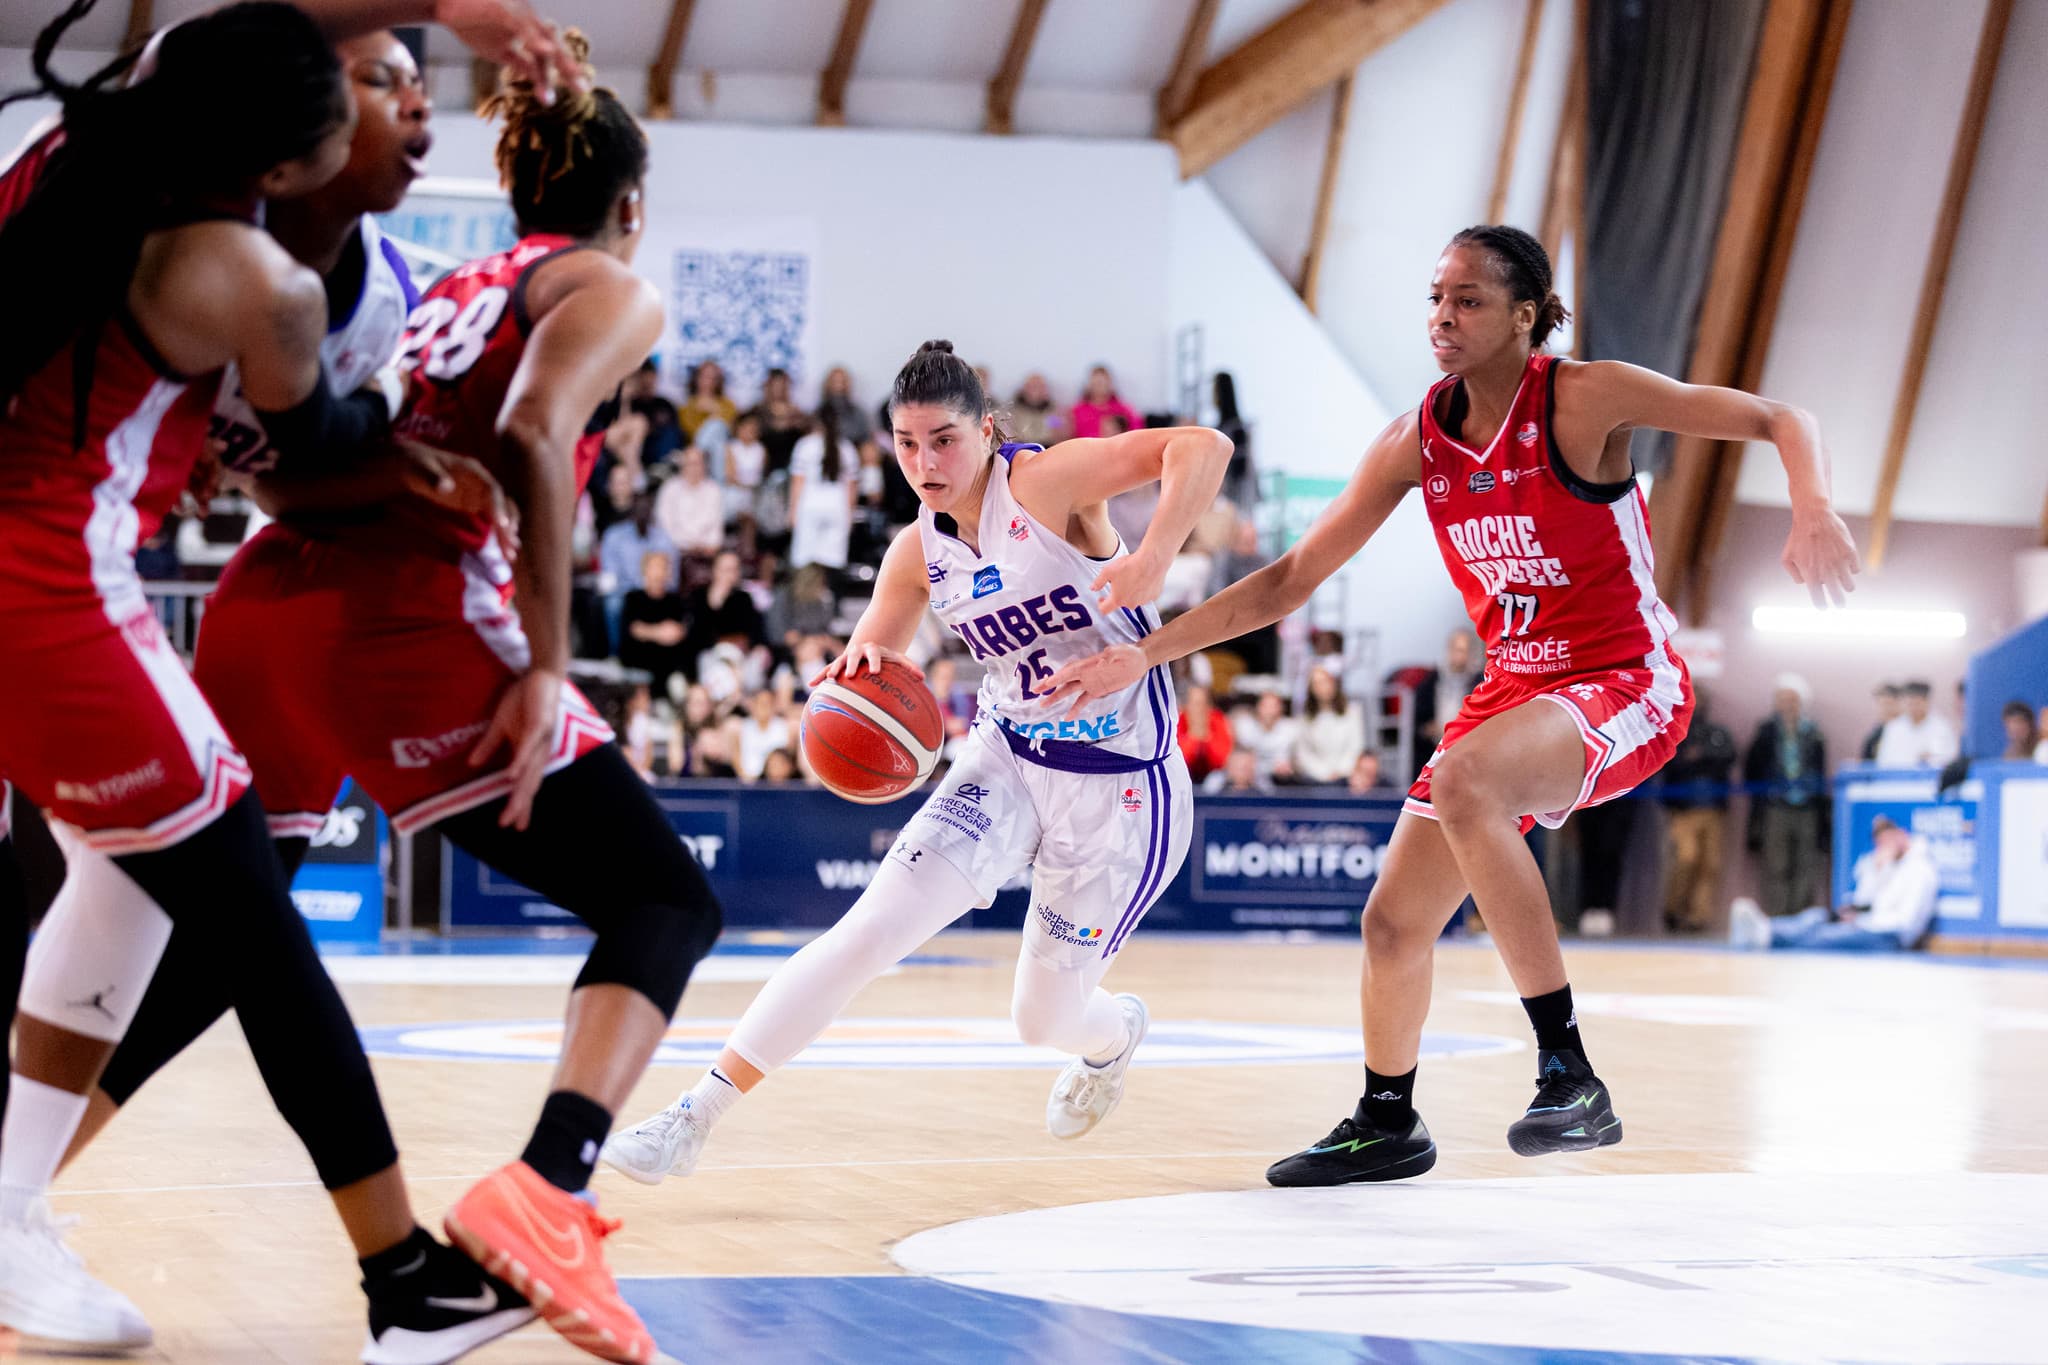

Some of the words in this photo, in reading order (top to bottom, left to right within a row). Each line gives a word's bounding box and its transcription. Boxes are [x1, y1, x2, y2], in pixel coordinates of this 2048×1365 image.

[387, 284, 509, 380] 28
[1432, 481, 1445, 493] U
[1446, 515, 1544, 561] ROCHE
[1497, 592, 1538, 637] 77
[930, 804, 988, 834] GASCOGNE
[1045, 906, 1076, 931] tarbes
[1049, 922, 1099, 947] pyrénées
